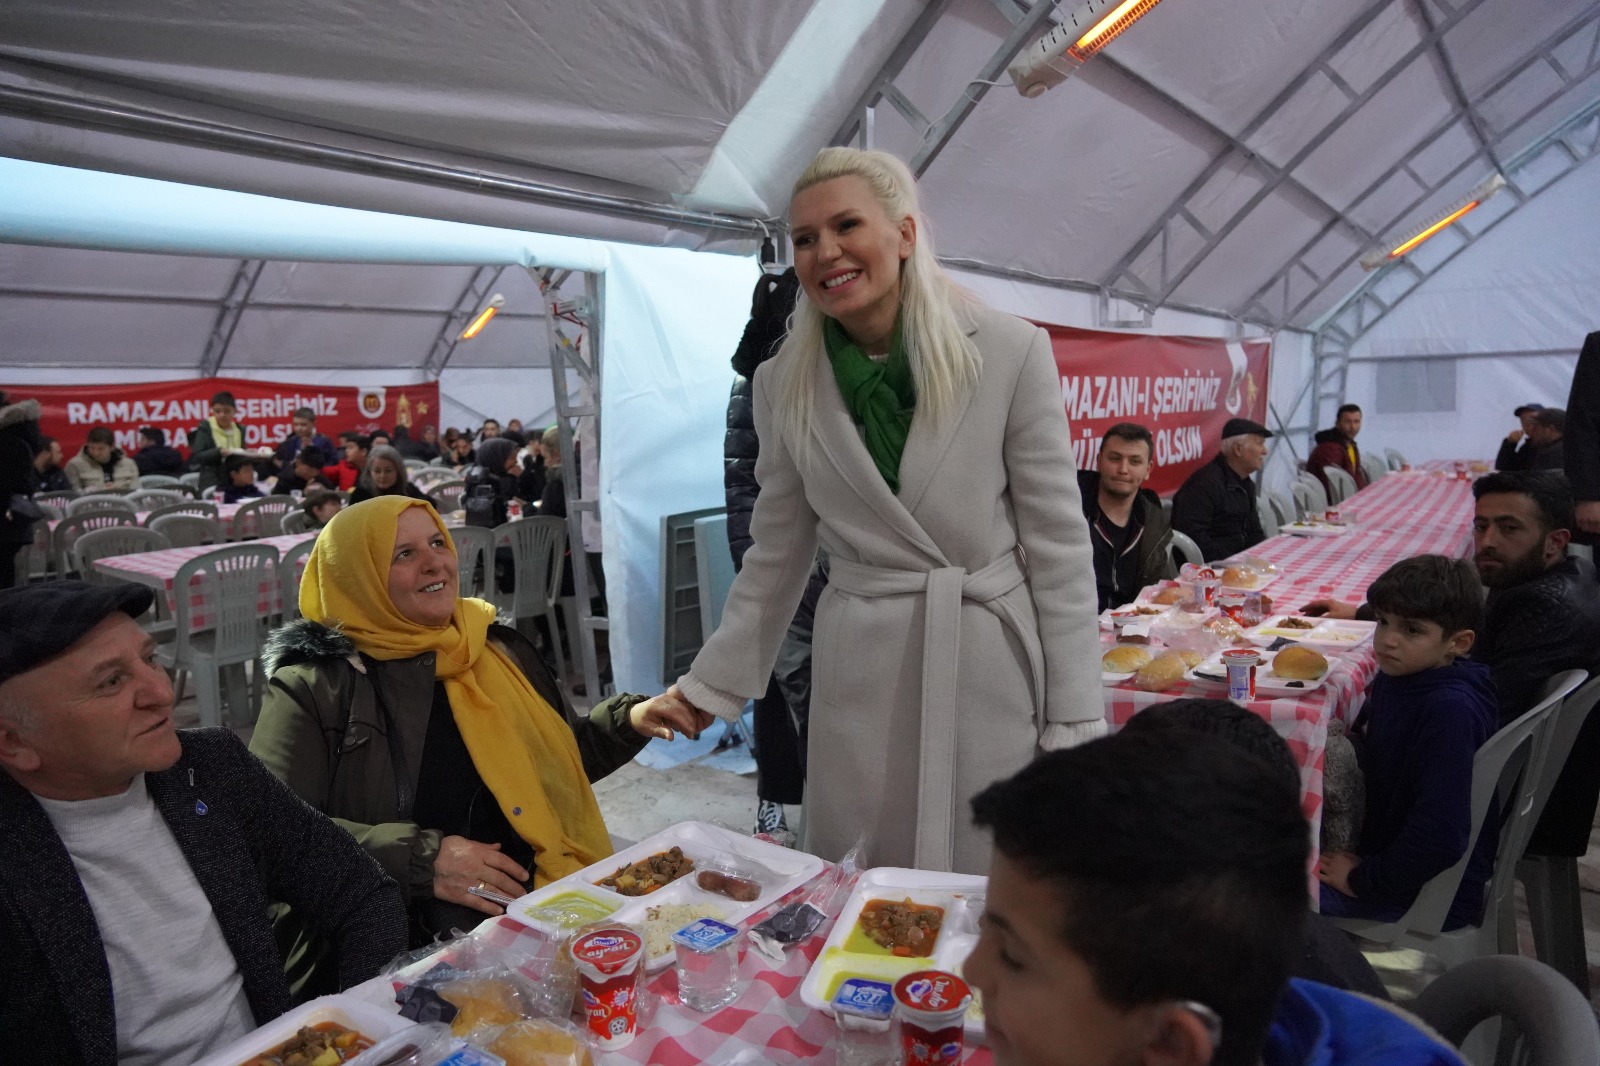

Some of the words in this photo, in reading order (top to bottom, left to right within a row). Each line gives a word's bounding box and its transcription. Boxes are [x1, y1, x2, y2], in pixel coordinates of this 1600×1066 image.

[1061, 375, 1150, 420] MAZANI-I
[1153, 370, 1221, 421] ŞERİFİMİZ
[67, 399, 213, 425] RAMAZANI-
[245, 423, 316, 445] OLS
[1156, 425, 1203, 467] OLSUN
[587, 942, 631, 959] ayran
